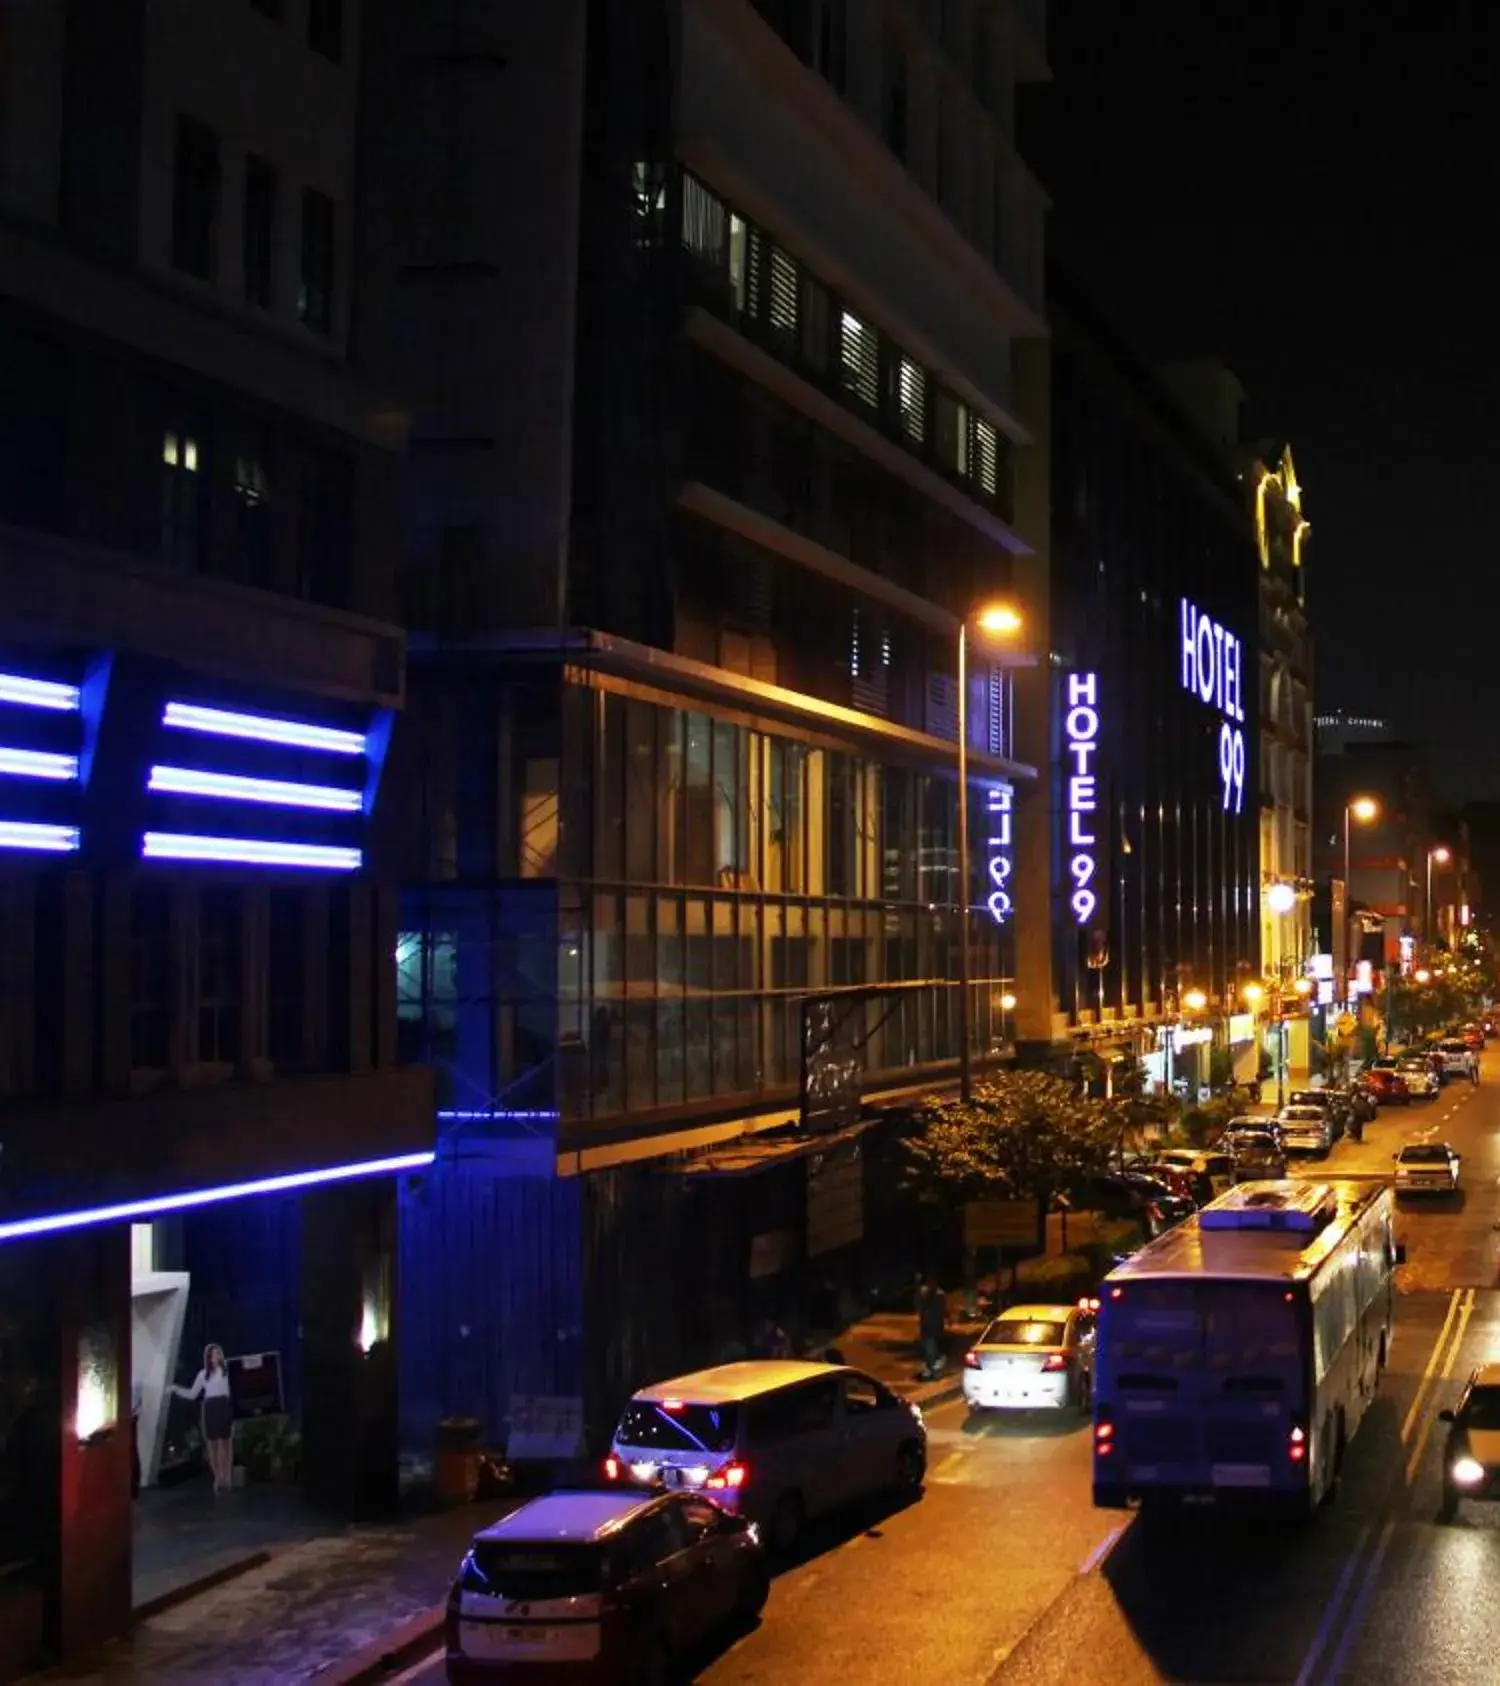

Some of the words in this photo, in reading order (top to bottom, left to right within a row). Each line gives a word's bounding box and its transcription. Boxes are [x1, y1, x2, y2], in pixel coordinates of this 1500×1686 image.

[1181, 597, 1245, 723] HOTEL
[1065, 673, 1099, 845] HOTEL
[1220, 722, 1245, 814] 99
[1070, 853, 1096, 923] 99
